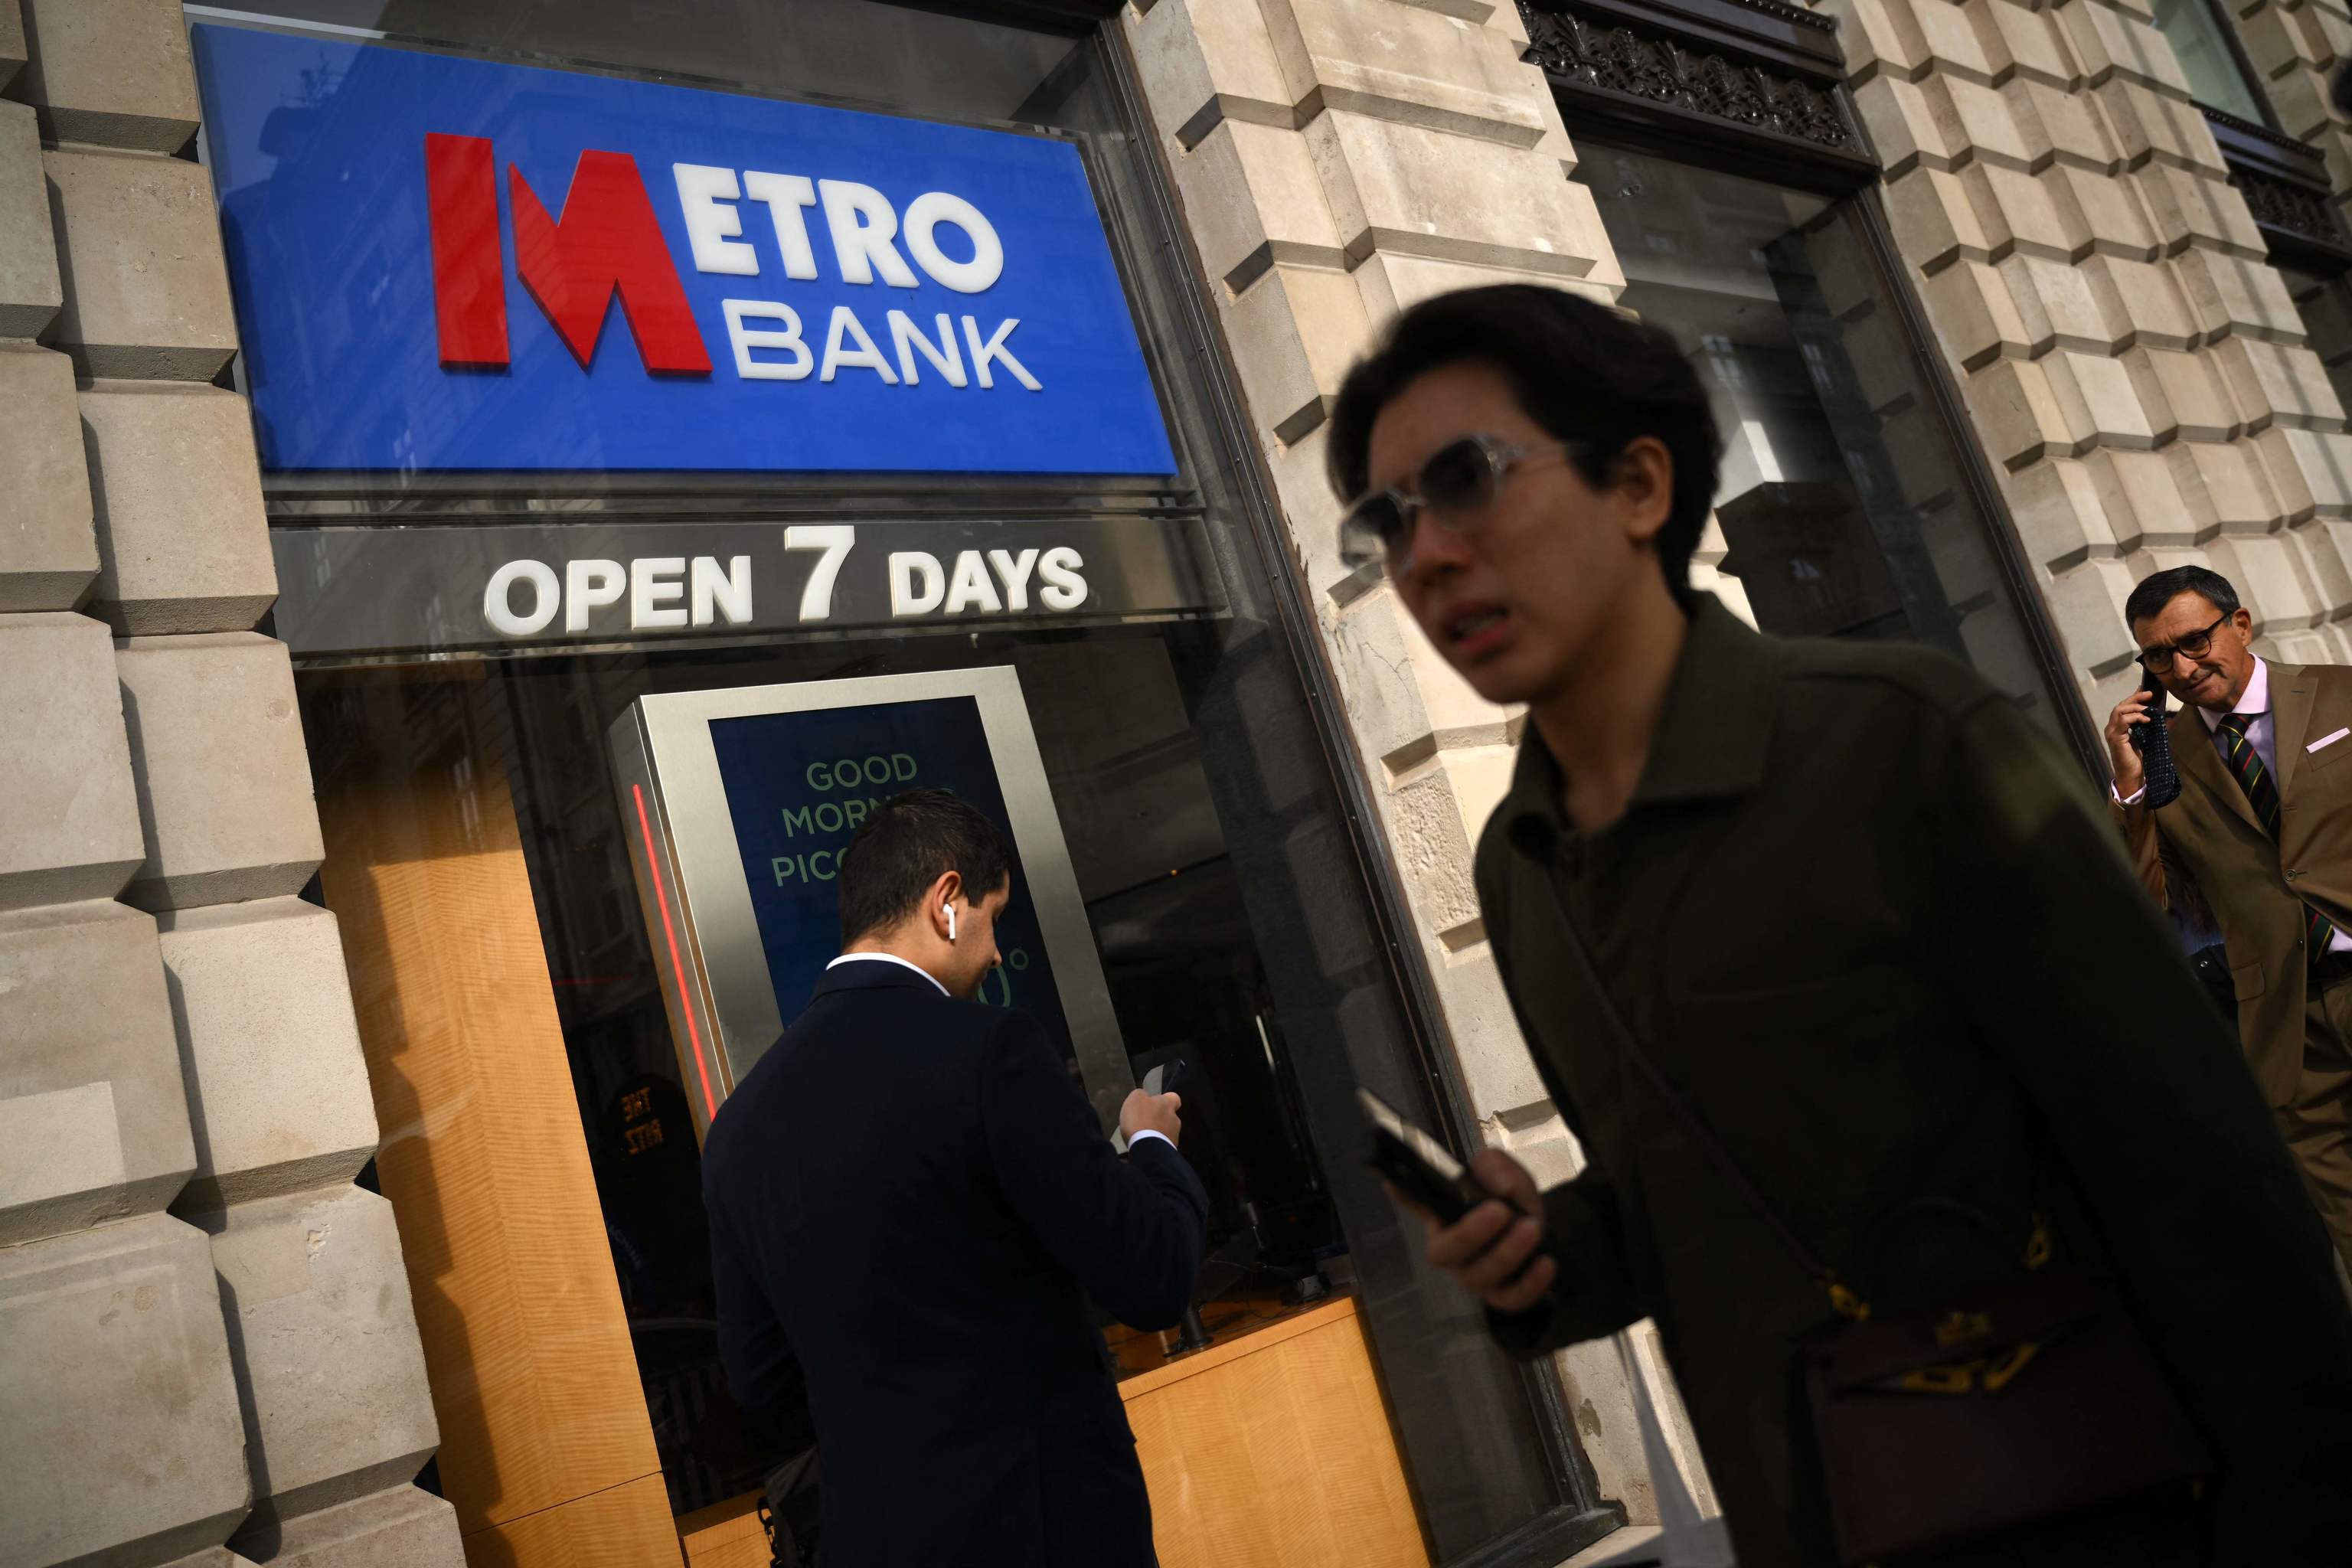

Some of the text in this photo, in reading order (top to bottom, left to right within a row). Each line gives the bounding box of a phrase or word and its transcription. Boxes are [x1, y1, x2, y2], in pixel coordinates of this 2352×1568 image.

[425, 132, 1004, 375] METRO
[722, 298, 1043, 391] BANK
[484, 525, 1088, 636] OPEN 7 DAYS
[806, 753, 918, 792] GOOD
